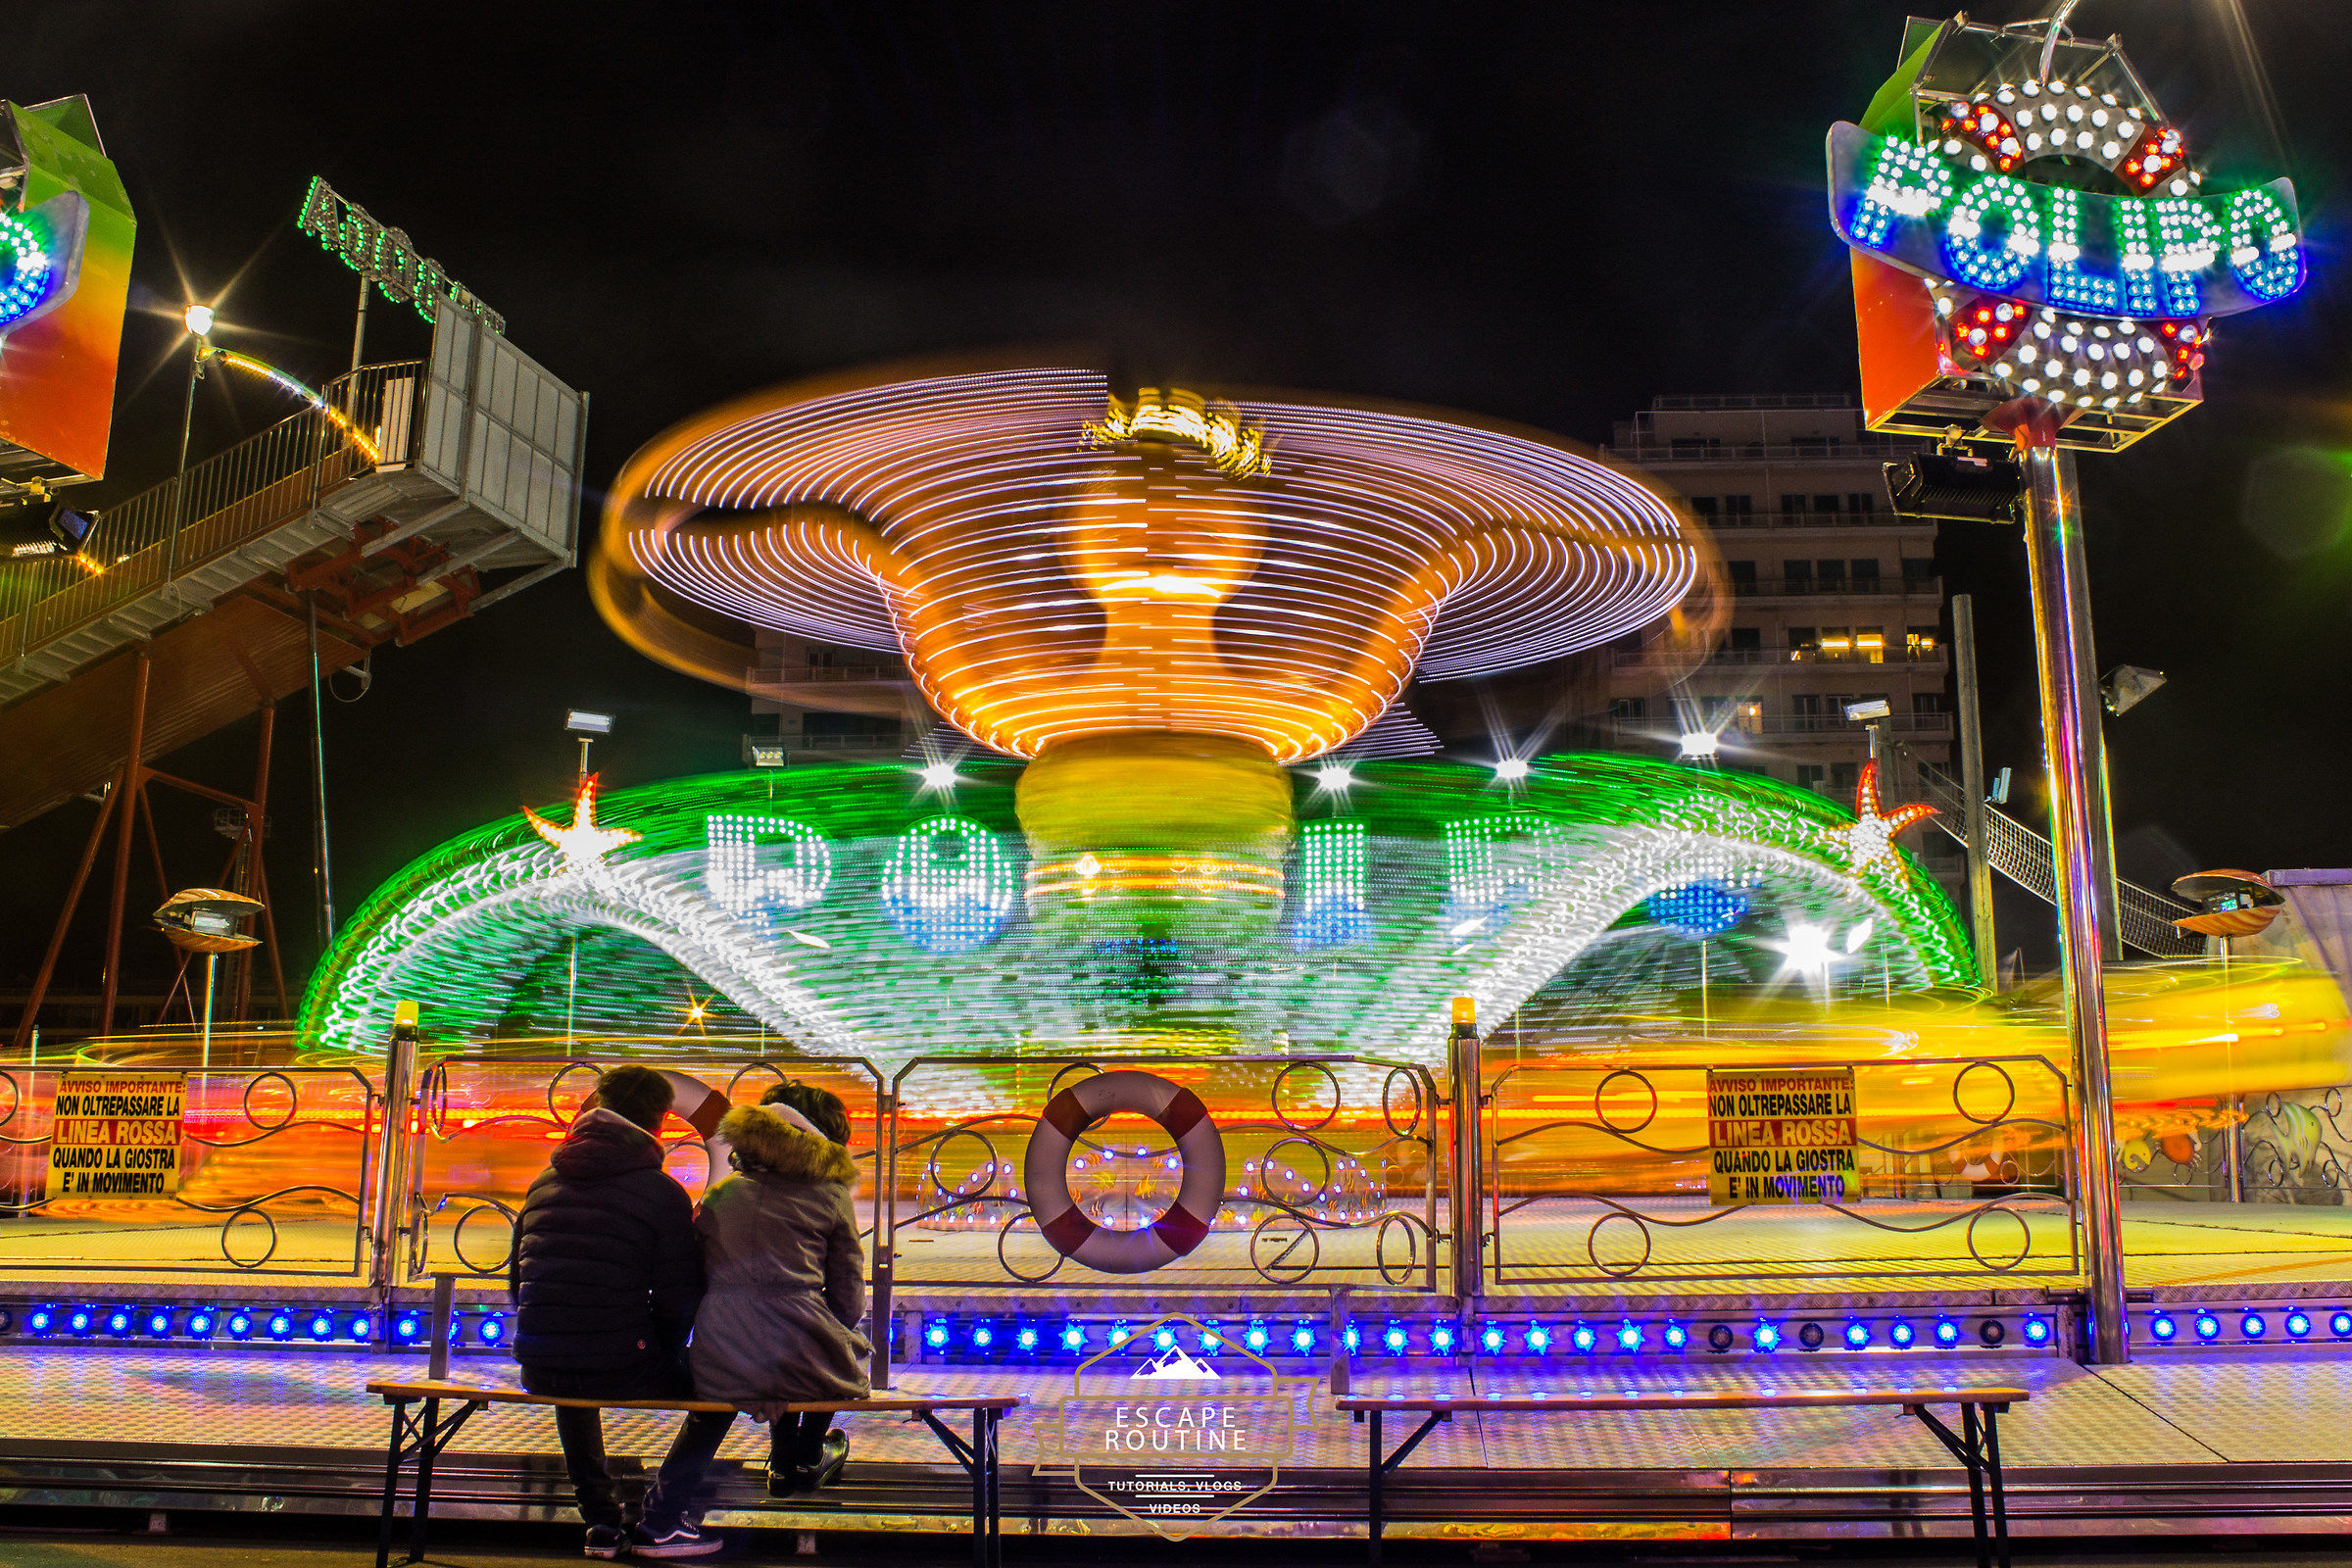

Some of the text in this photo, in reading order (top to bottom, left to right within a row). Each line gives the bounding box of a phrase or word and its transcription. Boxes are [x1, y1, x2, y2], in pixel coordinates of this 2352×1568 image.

[1851, 135, 2298, 317] POLIPO
[59, 1081, 186, 1094] AVVISO IMPORTANTE:
[1709, 1077, 1854, 1093] AVVISO IMPORTANTE:
[56, 1096, 179, 1116] NON OLTREPASSARE LA
[1709, 1093, 1852, 1117] NON OLTREPASSARE LA
[57, 1120, 176, 1145] LINEA ROSSA
[1715, 1119, 1852, 1147] LINEA ROSSA
[53, 1148, 174, 1169] QUANDO LA GIOSTRA
[1715, 1149, 1855, 1174] QUANDO LA GIOSTRA
[62, 1172, 165, 1194] E' IN MOVIMENTO
[1729, 1174, 1845, 1199] E' IN MOVIMENTO
